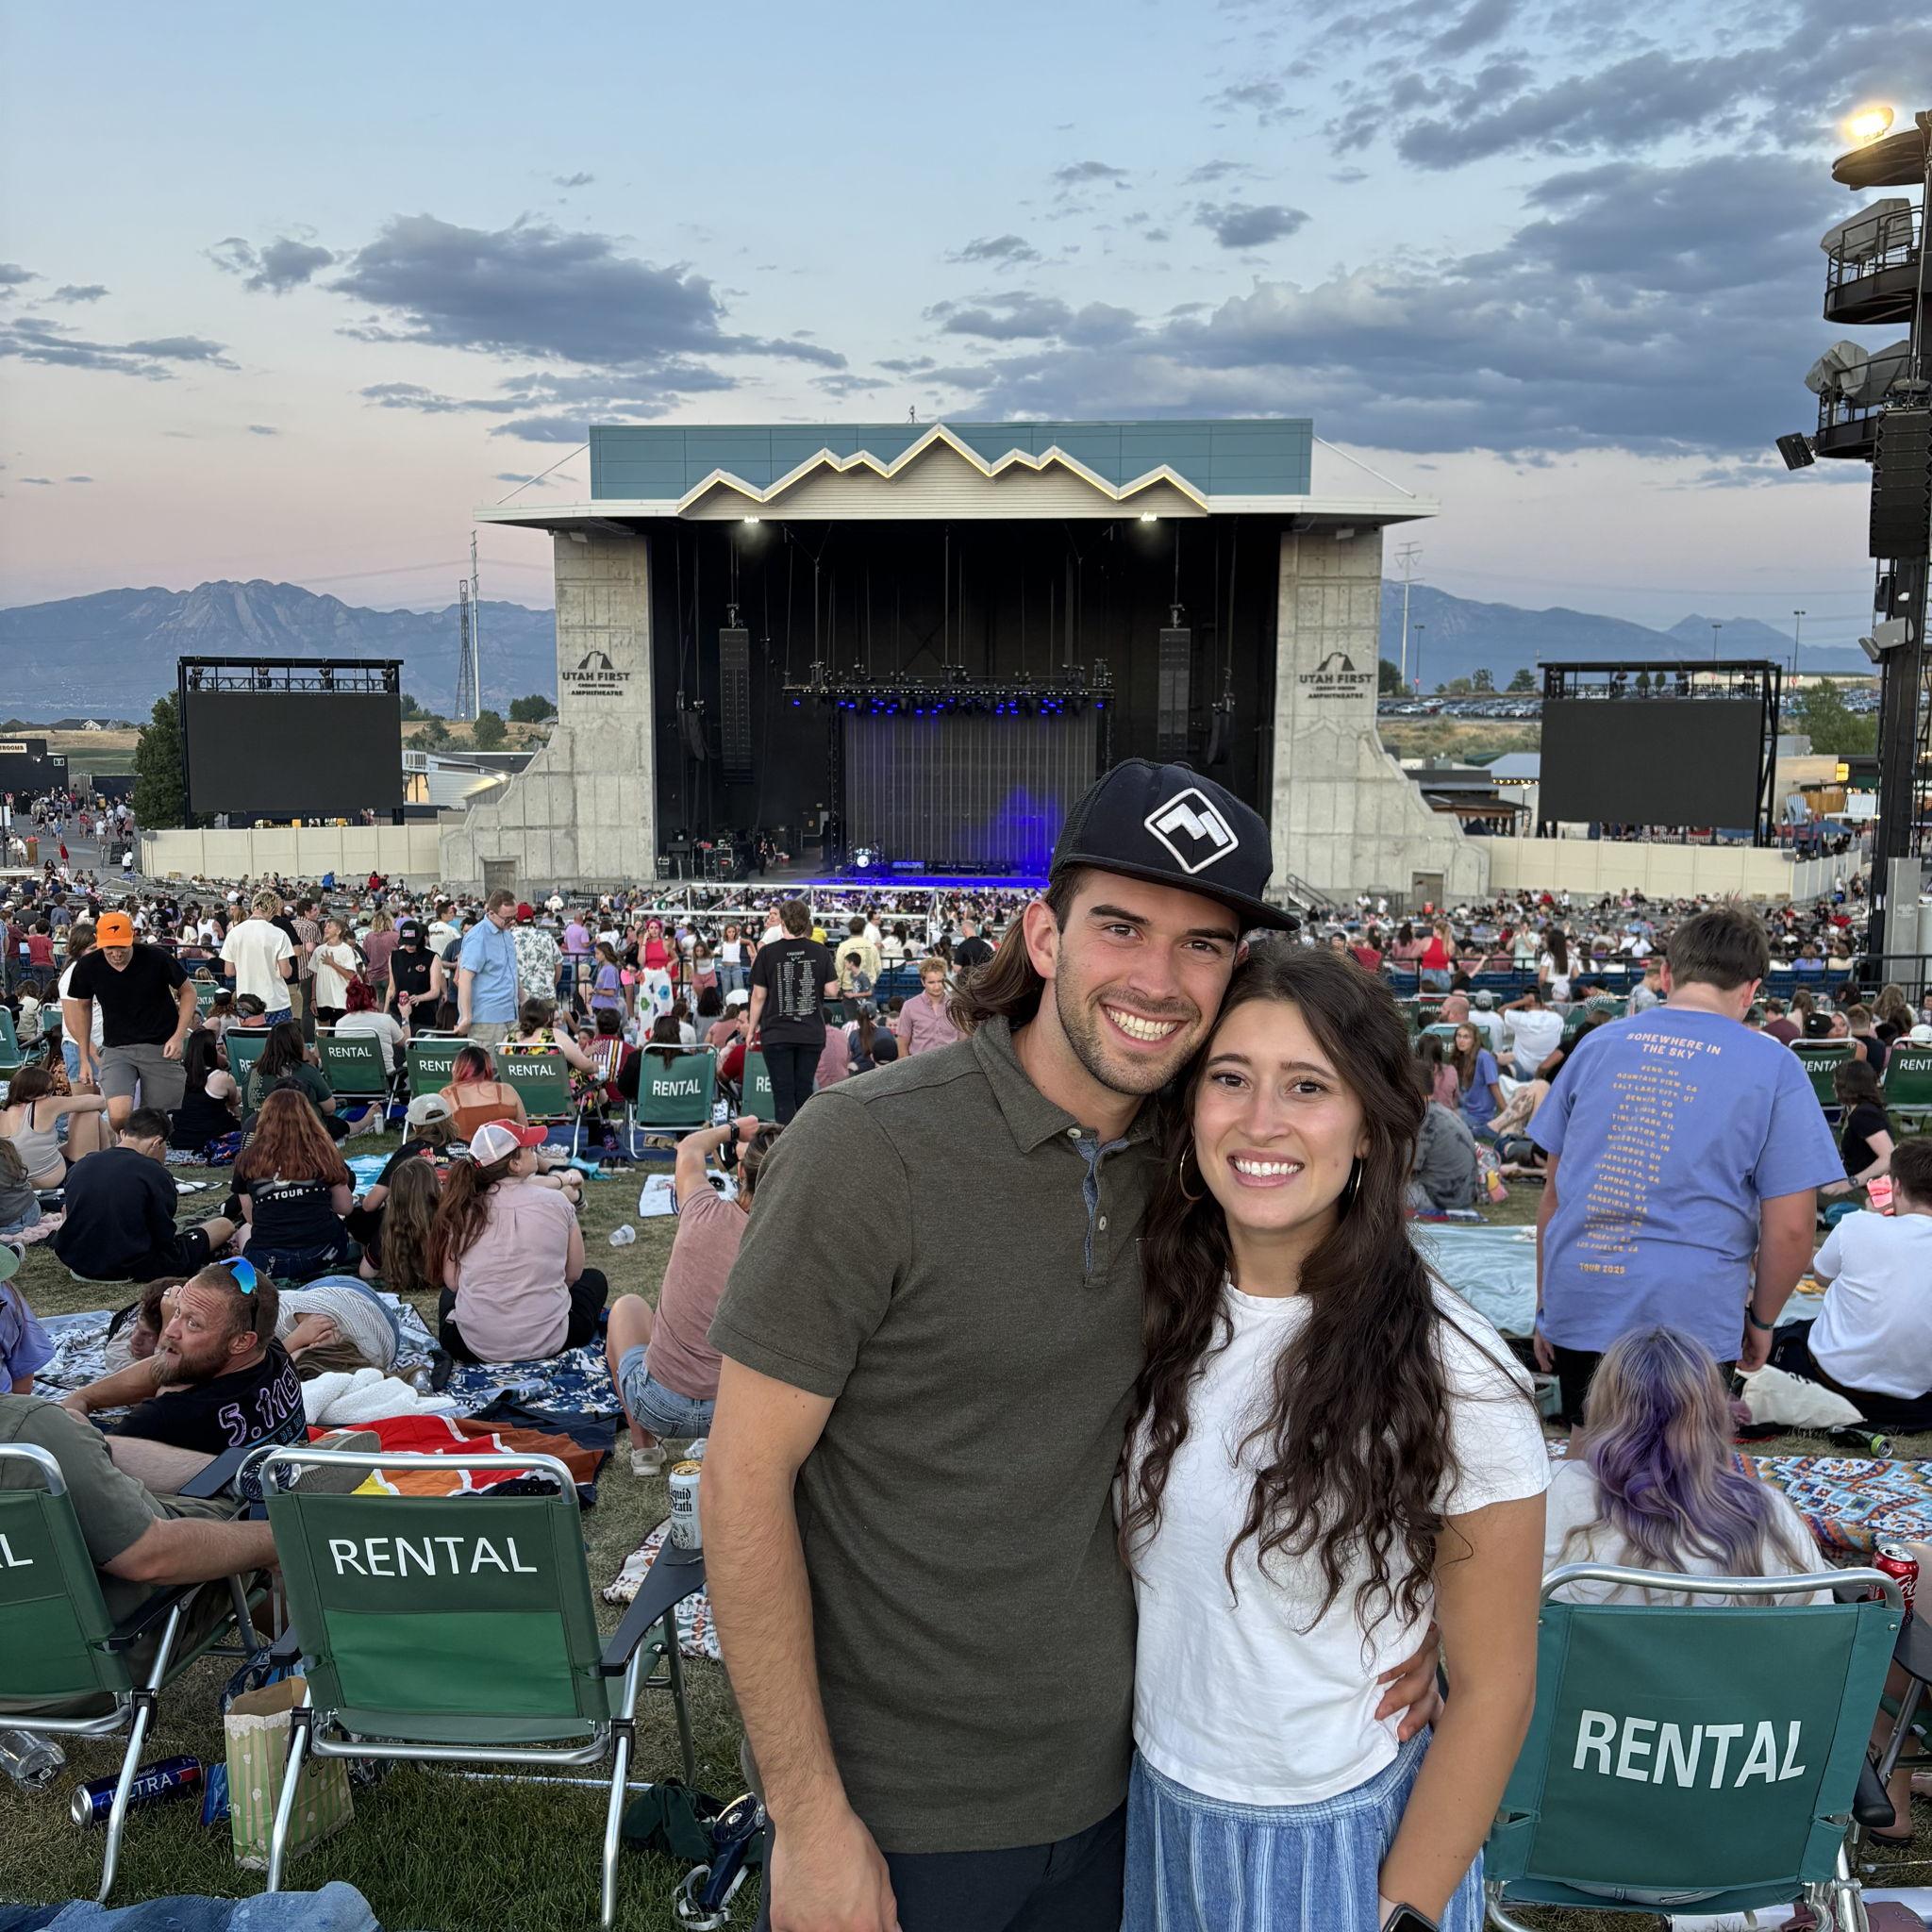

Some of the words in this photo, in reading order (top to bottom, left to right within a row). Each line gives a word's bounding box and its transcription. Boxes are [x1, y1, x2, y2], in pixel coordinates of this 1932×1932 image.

[562, 672, 594, 681] UTAH
[597, 672, 630, 681] FIRST
[1299, 675, 1333, 684] UTAH
[1337, 674, 1374, 684] FIRST
[1626, 1033, 1704, 1051] SOMEWHERE
[1707, 1043, 1722, 1056] IN
[1642, 1043, 1665, 1056] THE
[1669, 1045, 1695, 1059] SKY
[328, 1046, 373, 1058] RENTAL
[419, 1059, 452, 1073] RENT
[508, 1064, 557, 1077] RENTAL
[1899, 1058, 1932, 1071] RENT
[652, 1078, 701, 1097] RENTAL
[273, 1189, 304, 1200] TOUR
[1579, 1262, 1601, 1274] TOUR
[1602, 1265, 1626, 1275] 2025
[328, 1537, 538, 1576] RENTAL
[1573, 1709, 1807, 1790] RENTAL
